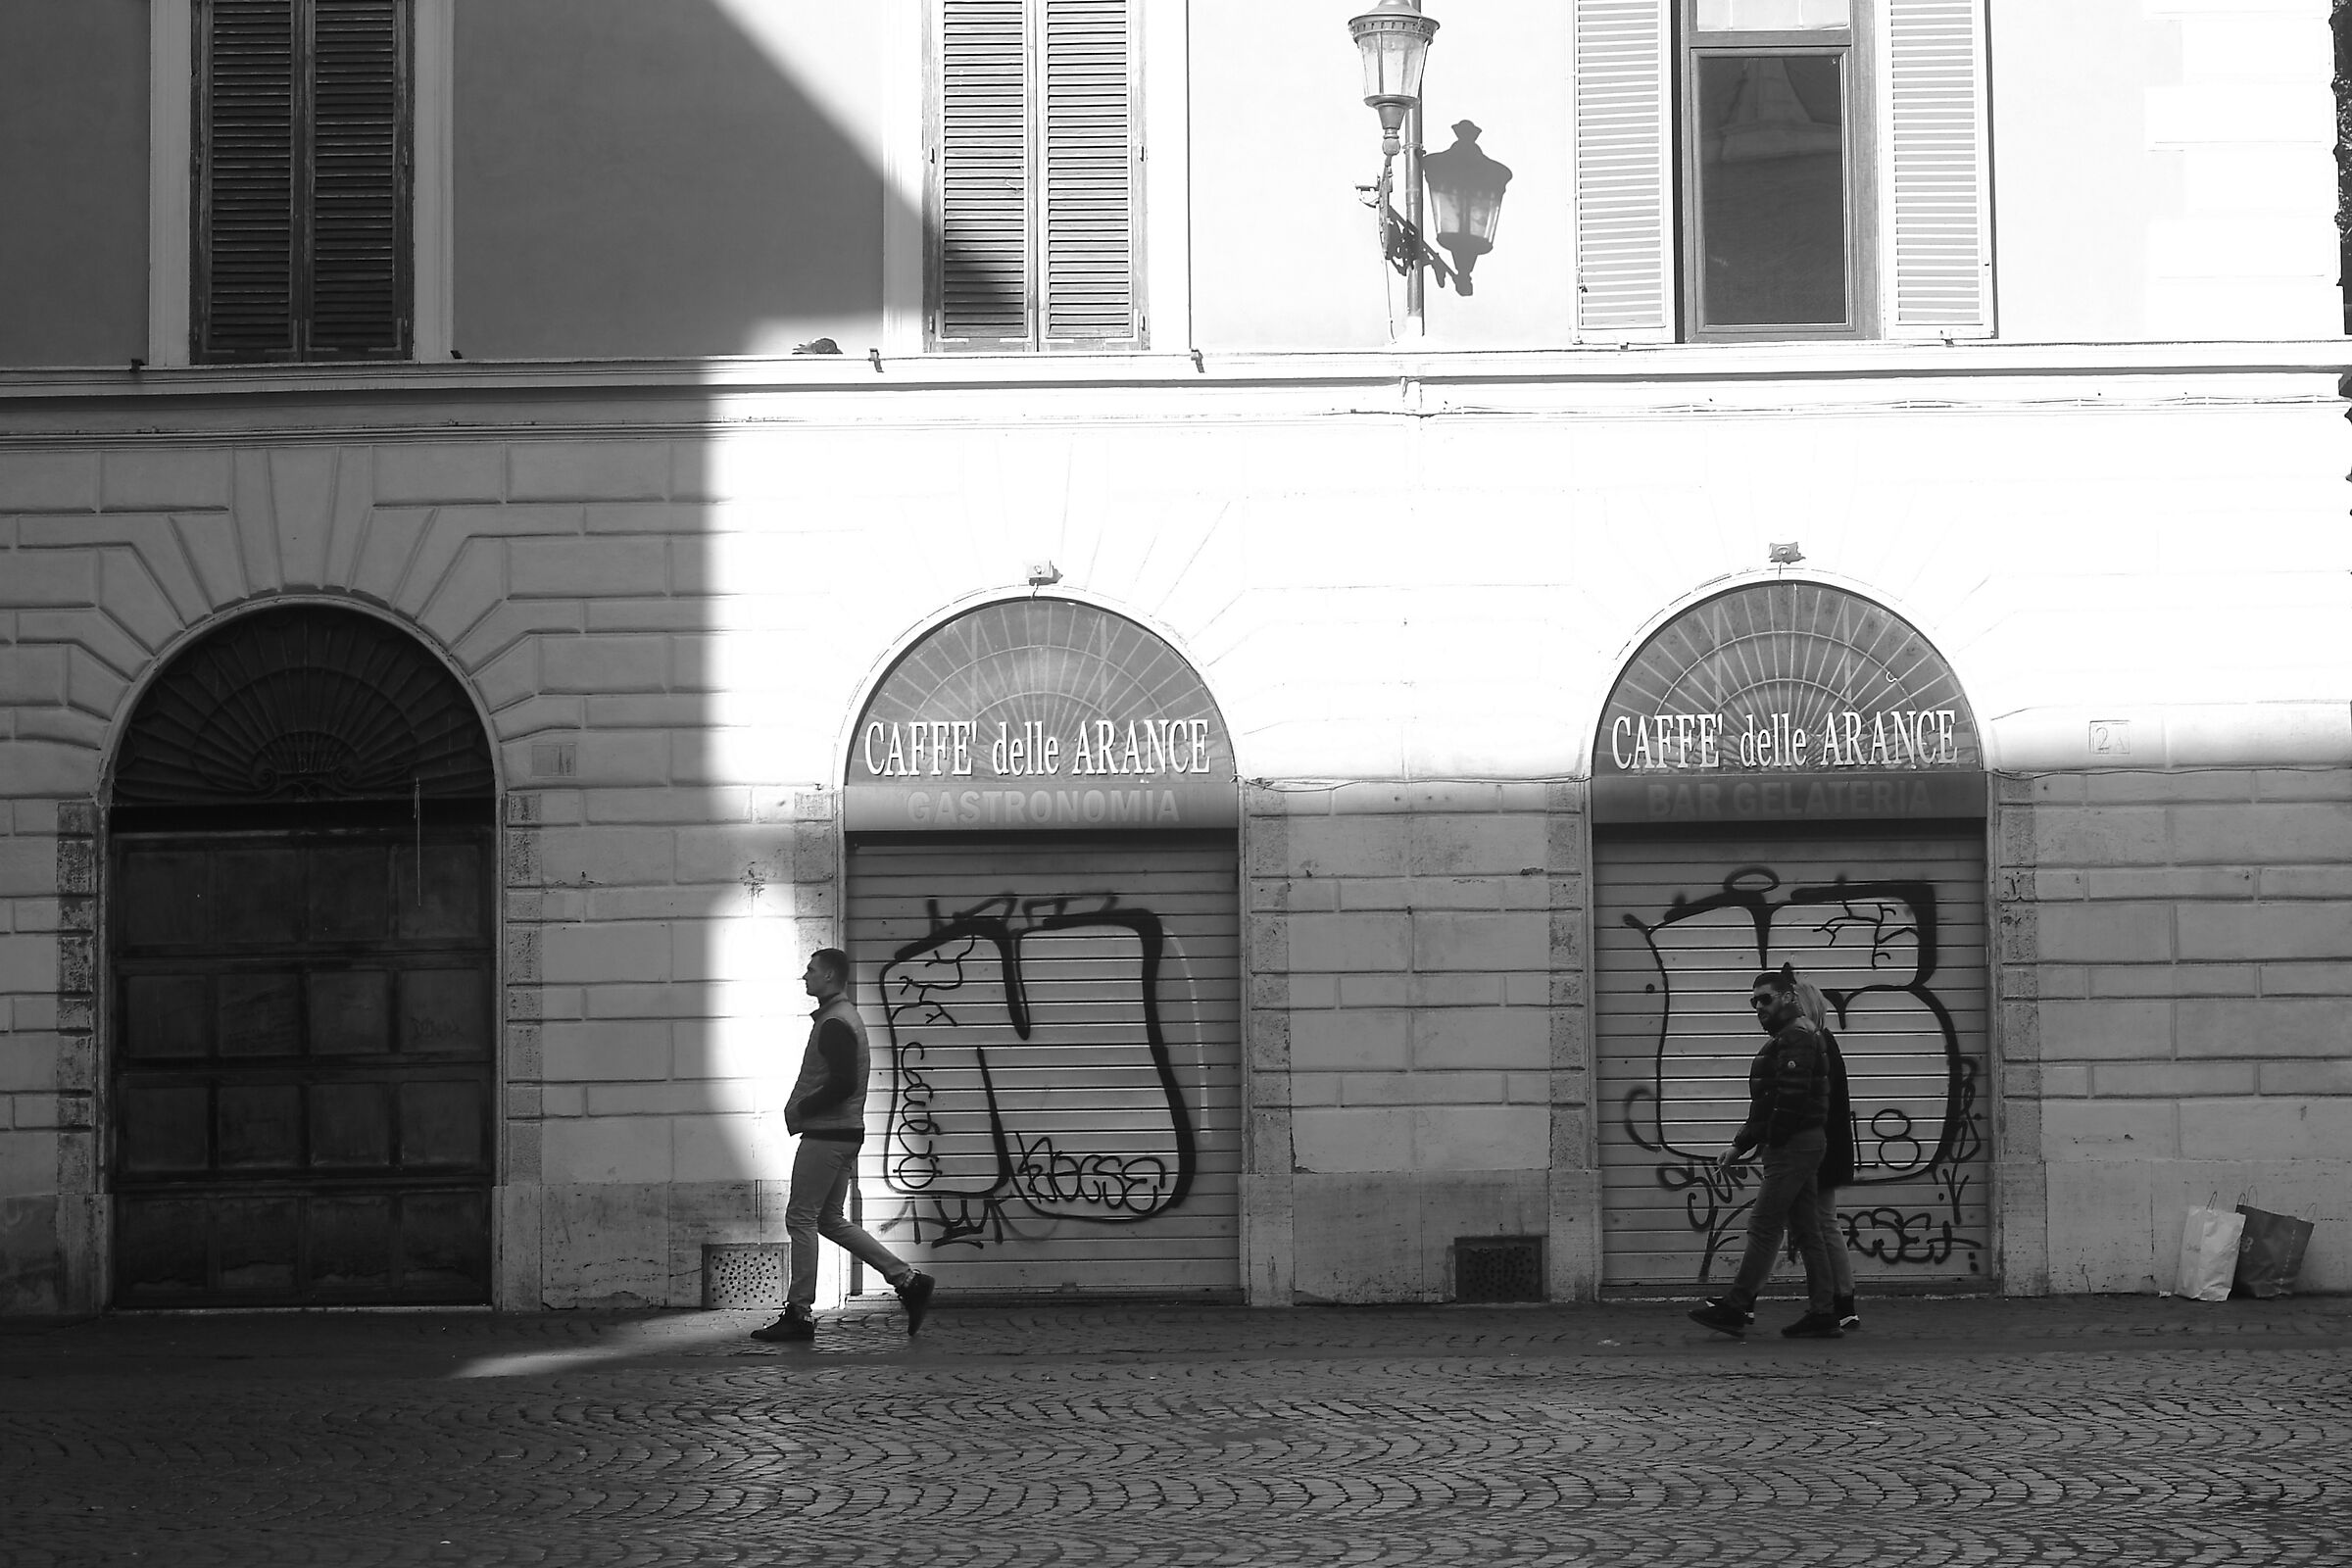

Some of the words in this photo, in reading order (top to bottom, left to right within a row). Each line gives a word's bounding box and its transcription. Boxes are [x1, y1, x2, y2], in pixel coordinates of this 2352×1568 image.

[864, 720, 978, 777] CAFFE'
[992, 720, 1059, 776] delle
[1071, 718, 1211, 775] ARANCE
[1612, 713, 1723, 769] CAFFE'
[1740, 712, 1808, 767] delle
[1820, 710, 1959, 766] ARANCE
[906, 789, 1181, 824] GASTRONOMIA
[1647, 783, 1721, 816] BAR
[1733, 780, 1932, 815] GELATERIA
